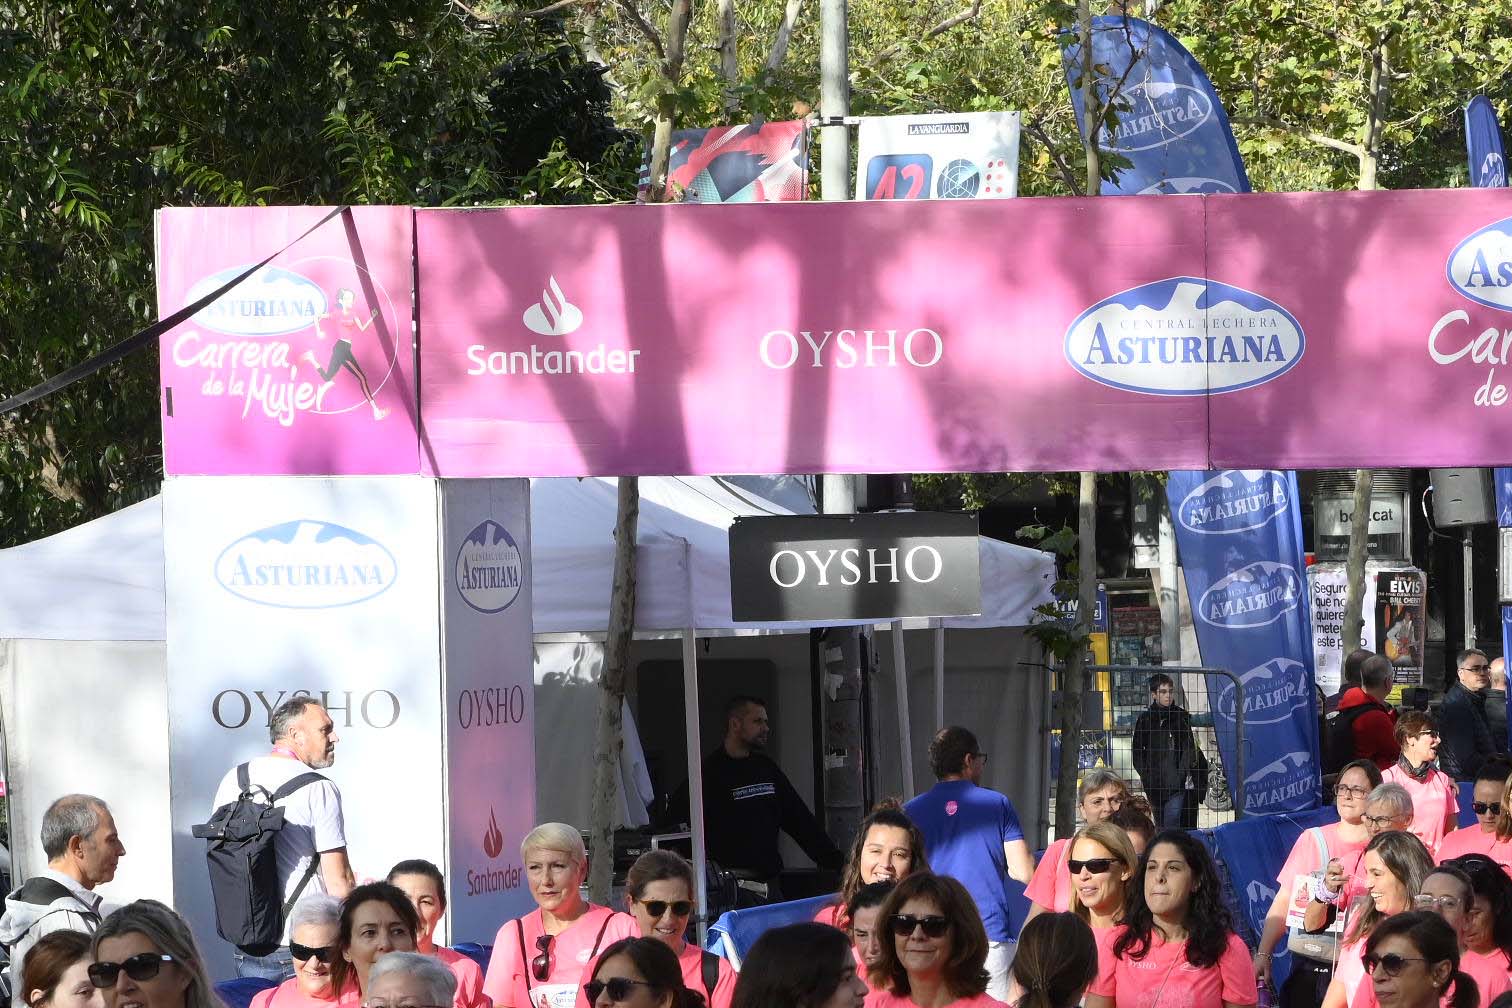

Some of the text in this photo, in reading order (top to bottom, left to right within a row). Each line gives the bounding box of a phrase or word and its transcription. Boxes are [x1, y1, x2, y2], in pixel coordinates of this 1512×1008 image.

[1119, 316, 1279, 330] CENTRAL LECHERA
[172, 331, 290, 368] Carrera
[466, 343, 640, 376] Santander
[759, 327, 946, 371] OYSHO
[1081, 331, 1287, 365] ASTURIANA
[202, 374, 244, 397] de la
[241, 365, 336, 427] Mujer
[1473, 376, 1512, 407] de
[227, 554, 385, 587] ASTURIANA
[460, 564, 519, 592] ASTURIANA
[768, 545, 944, 588] OYSHO
[1316, 598, 1331, 608] que
[1390, 581, 1421, 593] ELVIS
[1317, 636, 1336, 647] este
[458, 685, 525, 729] OYSHO
[467, 863, 523, 897] Santander
